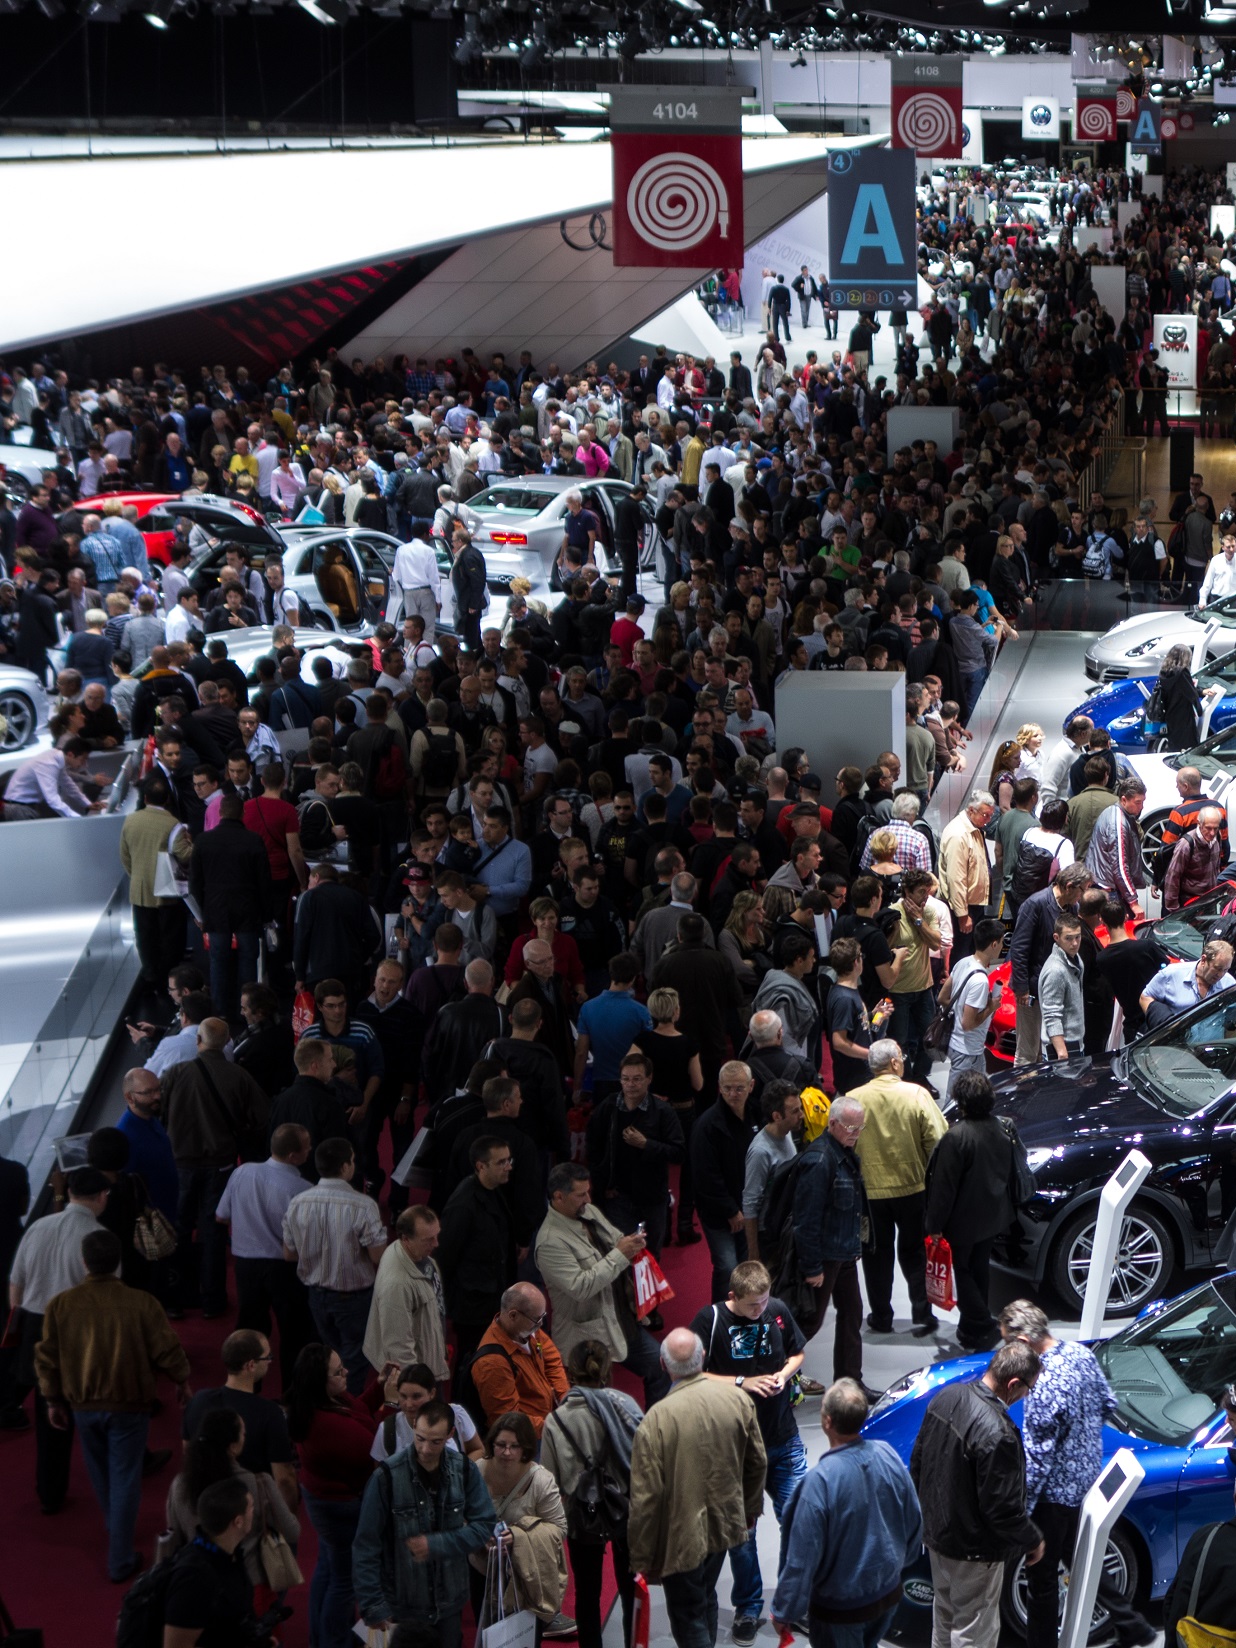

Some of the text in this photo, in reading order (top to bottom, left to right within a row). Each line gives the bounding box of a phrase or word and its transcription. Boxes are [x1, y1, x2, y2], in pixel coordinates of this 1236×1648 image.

[914, 66, 939, 76] 4108
[653, 102, 698, 119] 4104
[1134, 110, 1157, 139] A
[834, 154, 845, 169] 4
[840, 183, 905, 265] A
[835, 293, 842, 304] 3
[1161, 341, 1190, 353] TOYOTA
[633, 1256, 669, 1306] RTL
[910, 1589, 934, 1602] ROVER
[911, 1582, 931, 1595] LAND
